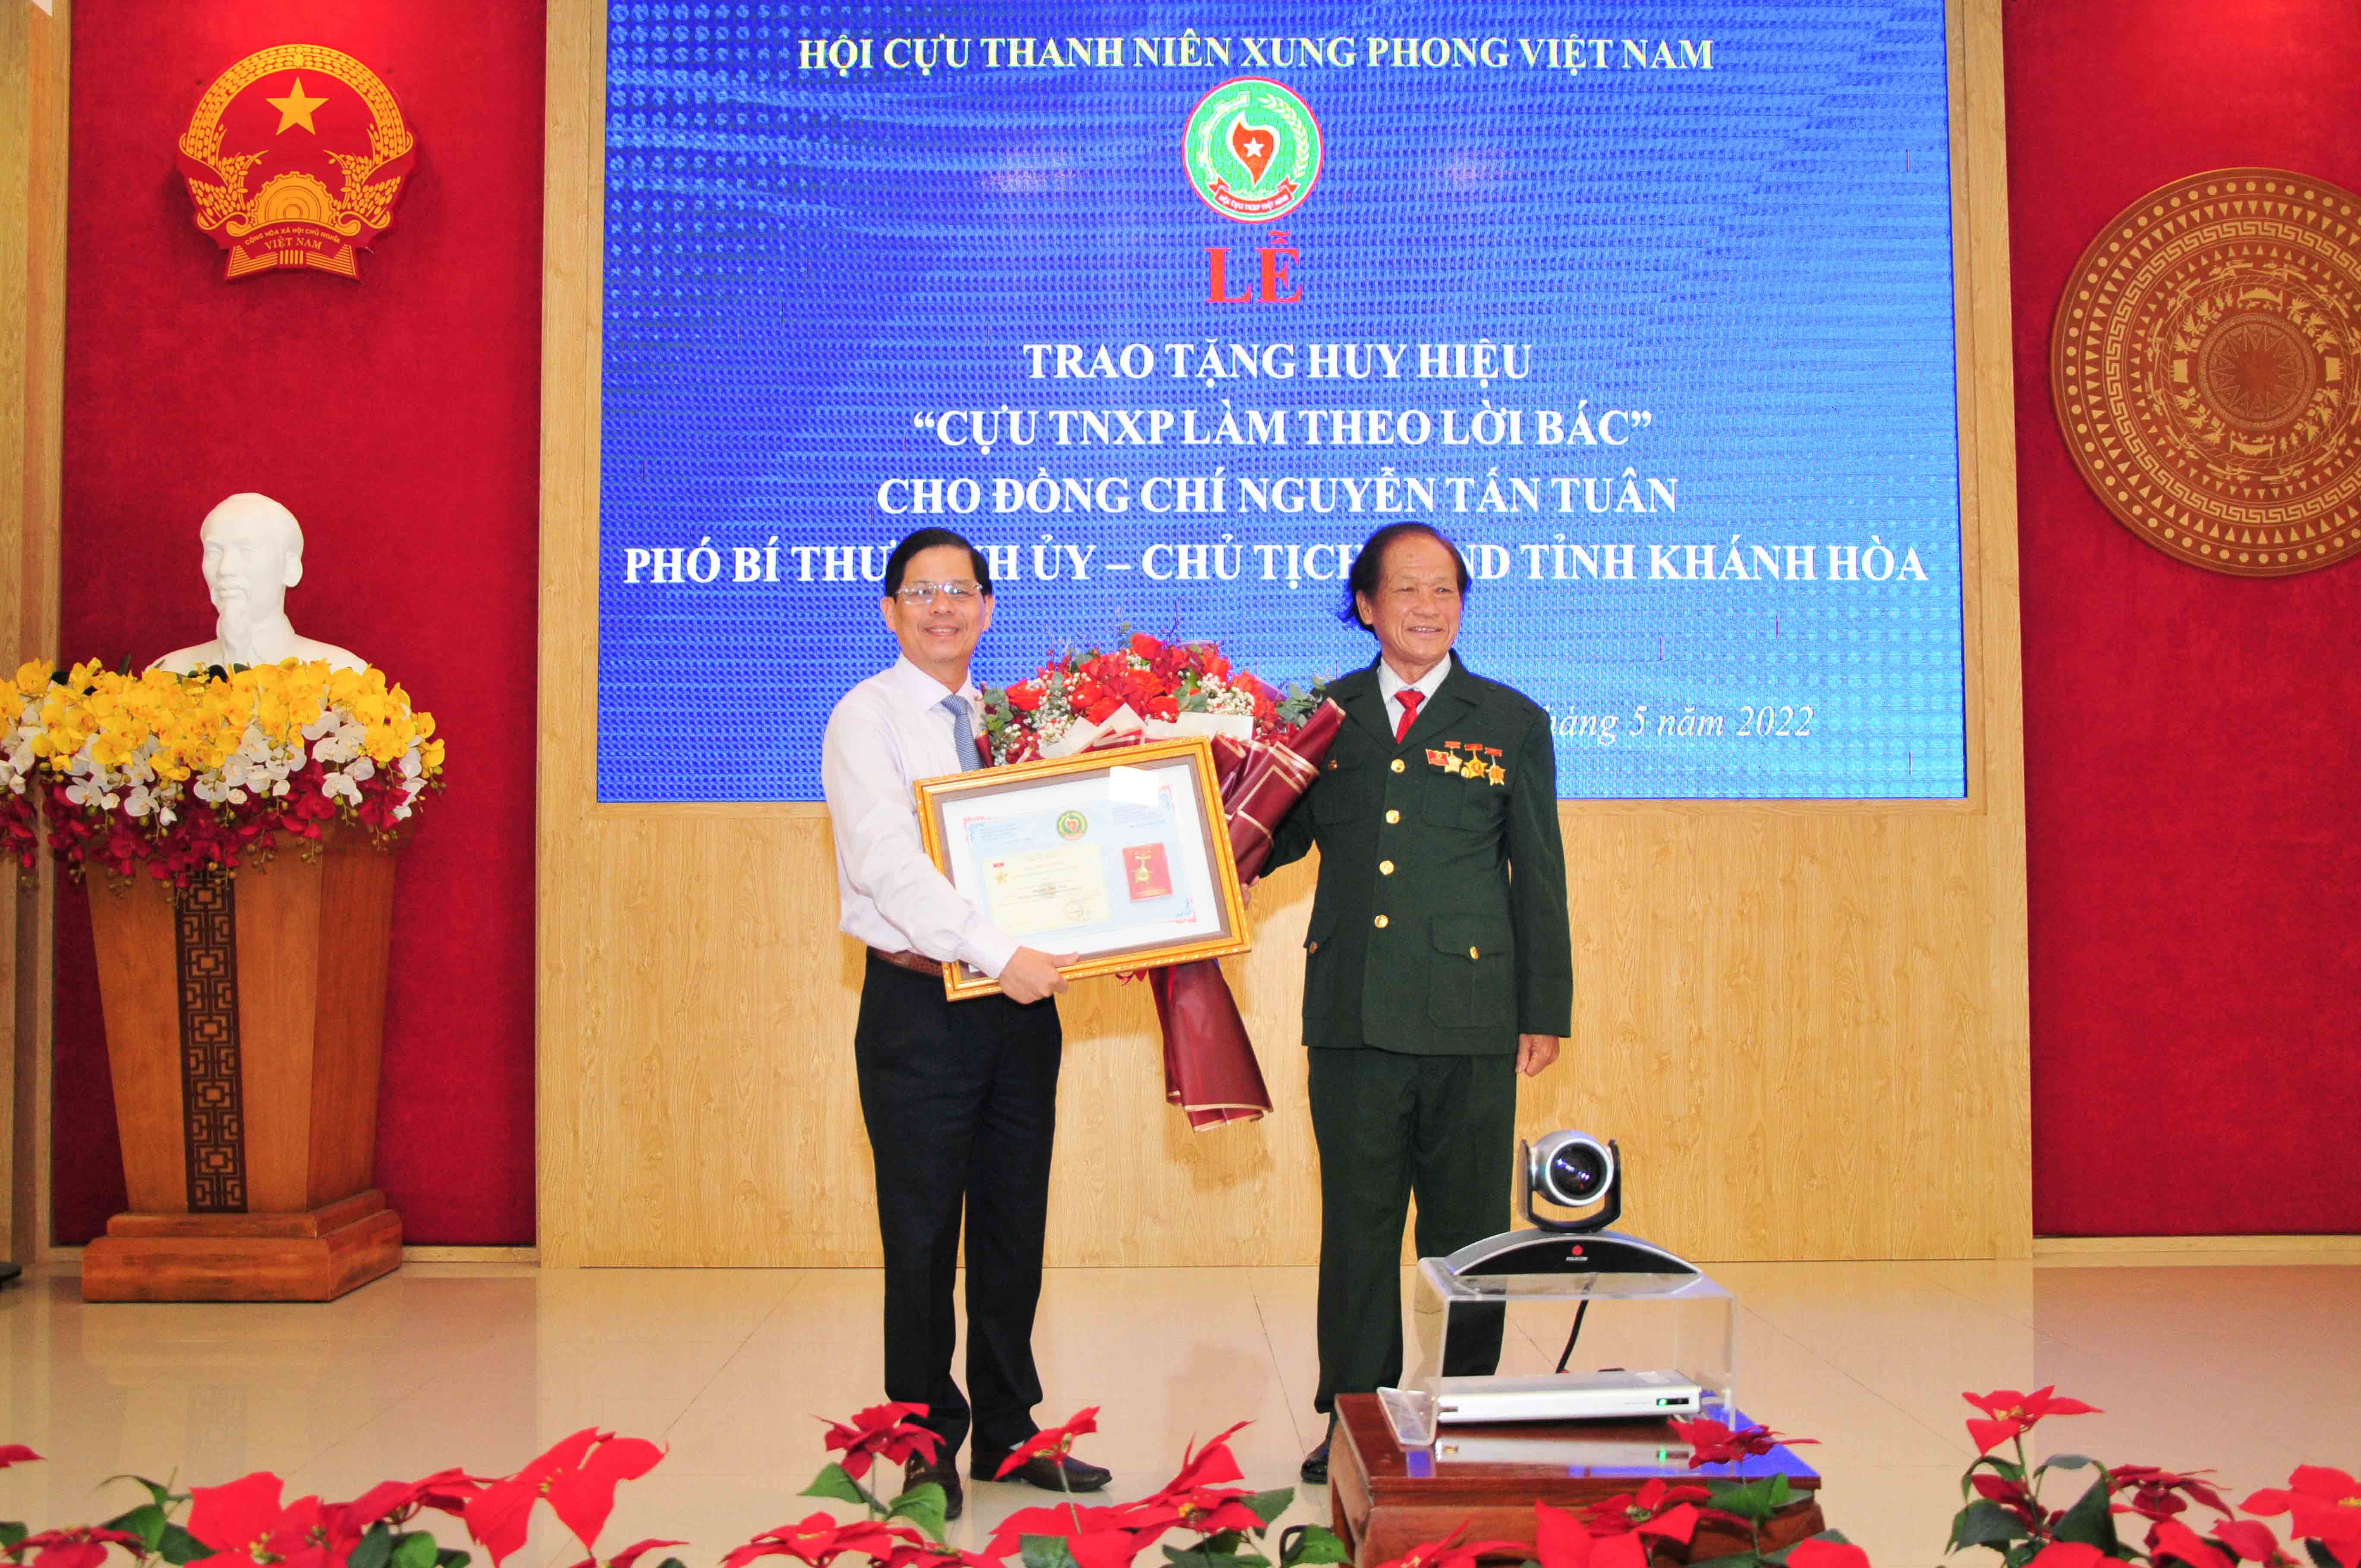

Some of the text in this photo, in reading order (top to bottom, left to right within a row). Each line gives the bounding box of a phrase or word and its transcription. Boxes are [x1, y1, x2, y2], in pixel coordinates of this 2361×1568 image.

[799, 28, 1713, 76] HỘI CỰU THANH NIÊN XUNG PHONG VIỆT NAM
[264, 235, 323, 250] VIỆT NAM
[1203, 230, 1302, 303] LỄ
[1023, 337, 1531, 388] TRAO TẶNG HUY HIỆU
[913, 399, 1652, 455] “CỰU TNXP LÀM THEO LỜI BÁC”
[877, 466, 1678, 514] CHO ĐỒNG CHÍ NGUYỄN TẤN TUÂN
[623, 536, 721, 583] PHÓ
[732, 535, 780, 582] BÍ
[1031, 533, 1097, 580] ỦY
[1141, 533, 1243, 580] CHỦ
[1520, 533, 1637, 580] TỈNH
[1647, 534, 1817, 580] KHÁNH
[1827, 535, 1929, 581] HÒA
[1629, 705, 1648, 737] 5
[1657, 706, 1724, 737] năm
[1736, 705, 1813, 737] 2022
